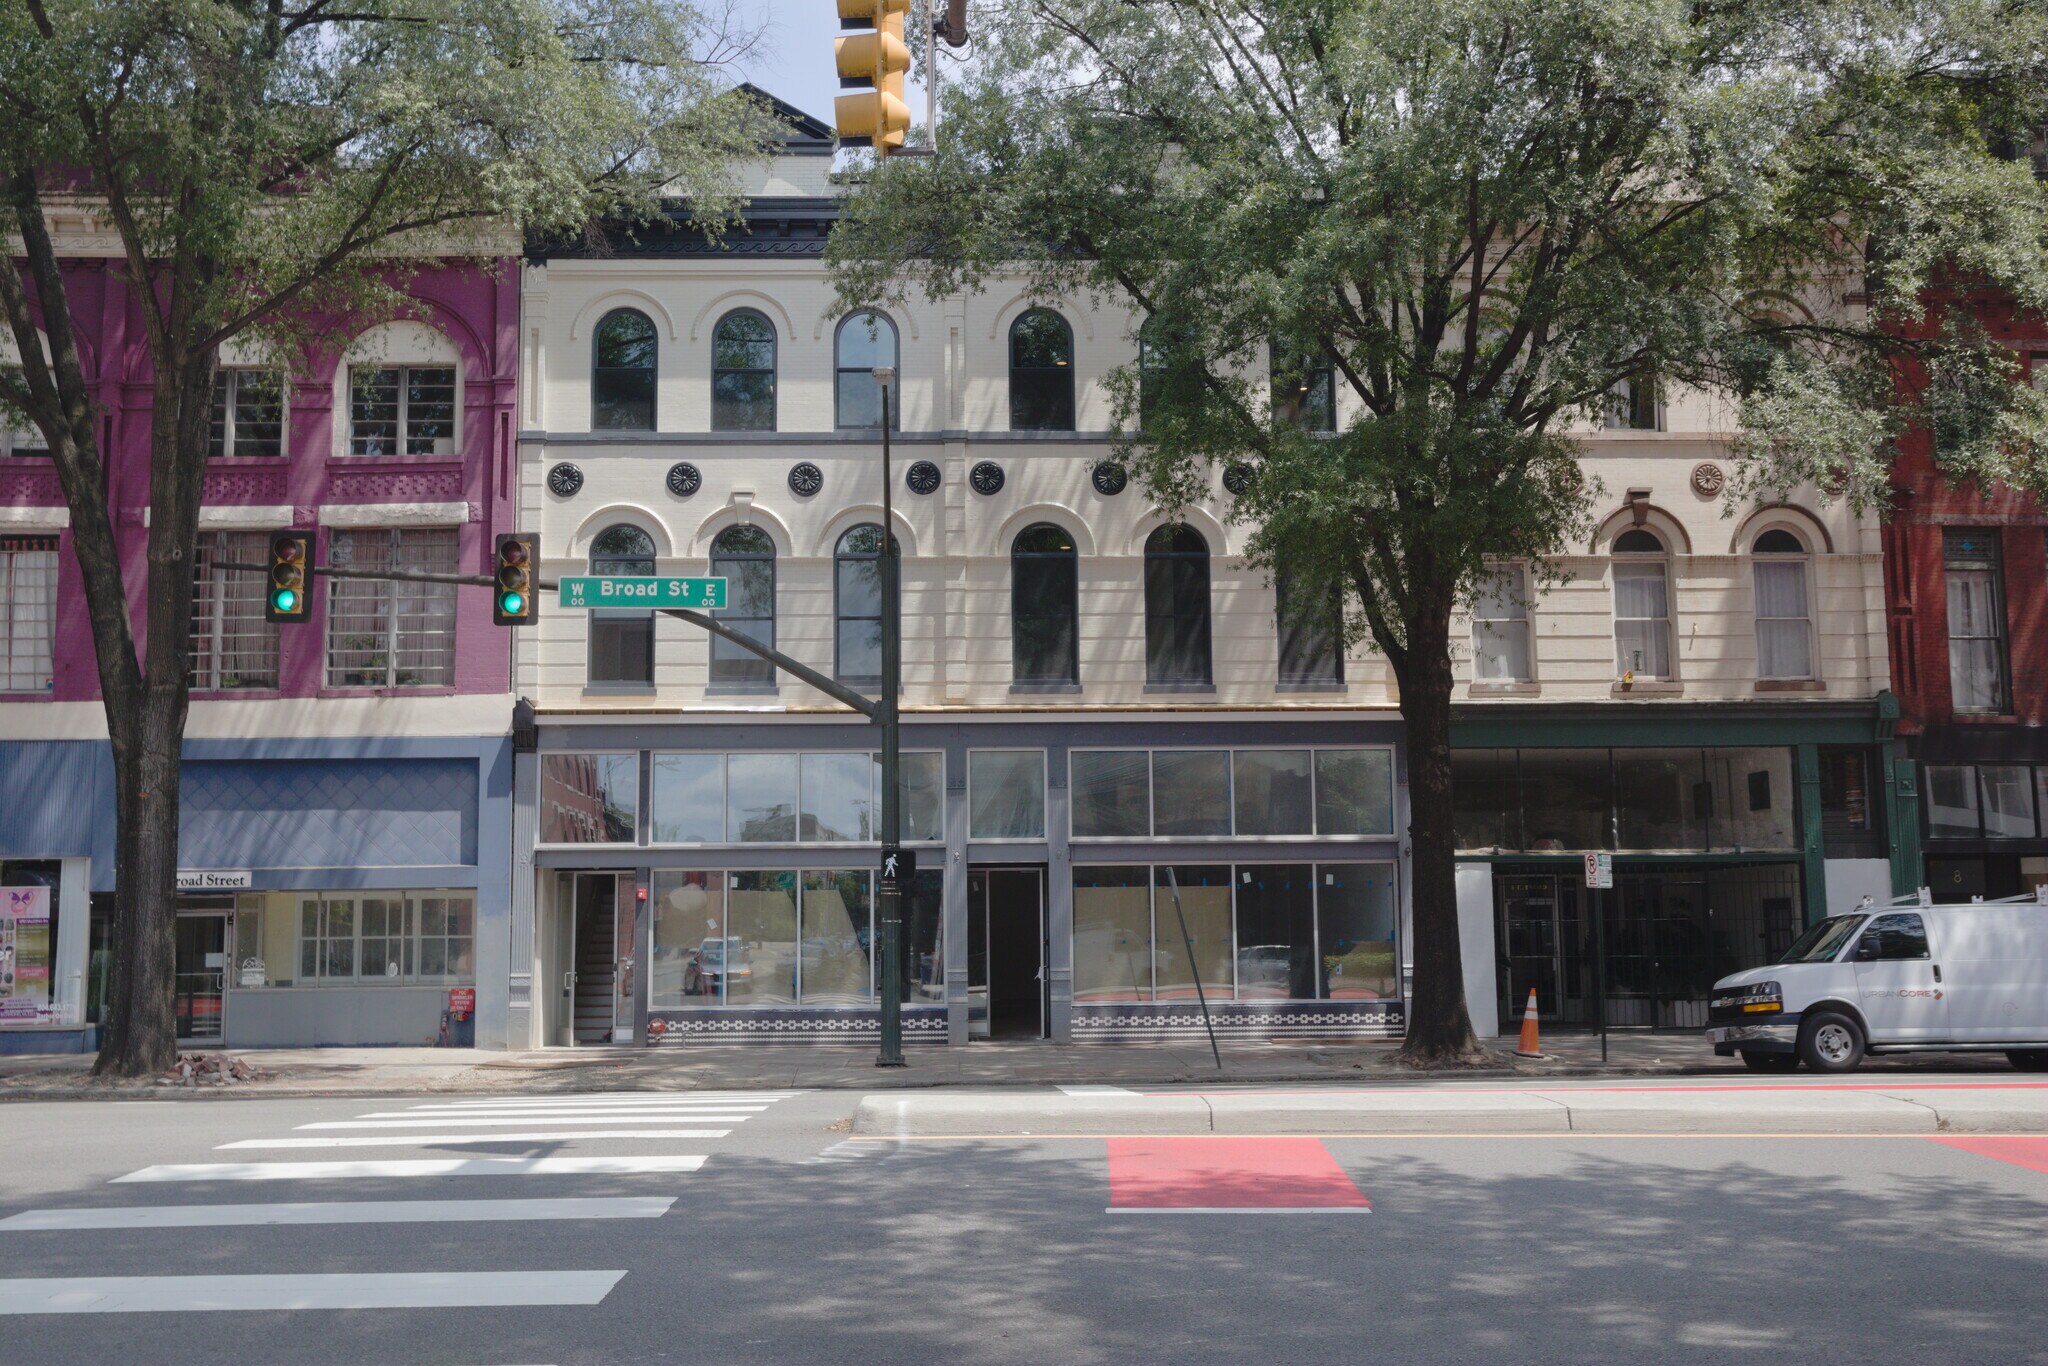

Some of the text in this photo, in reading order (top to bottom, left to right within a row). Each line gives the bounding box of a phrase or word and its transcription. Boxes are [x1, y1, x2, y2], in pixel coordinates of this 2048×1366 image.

[571, 580, 716, 596] W Broad St E
[176, 874, 245, 886] road Street
[1953, 869, 1962, 883] 8
